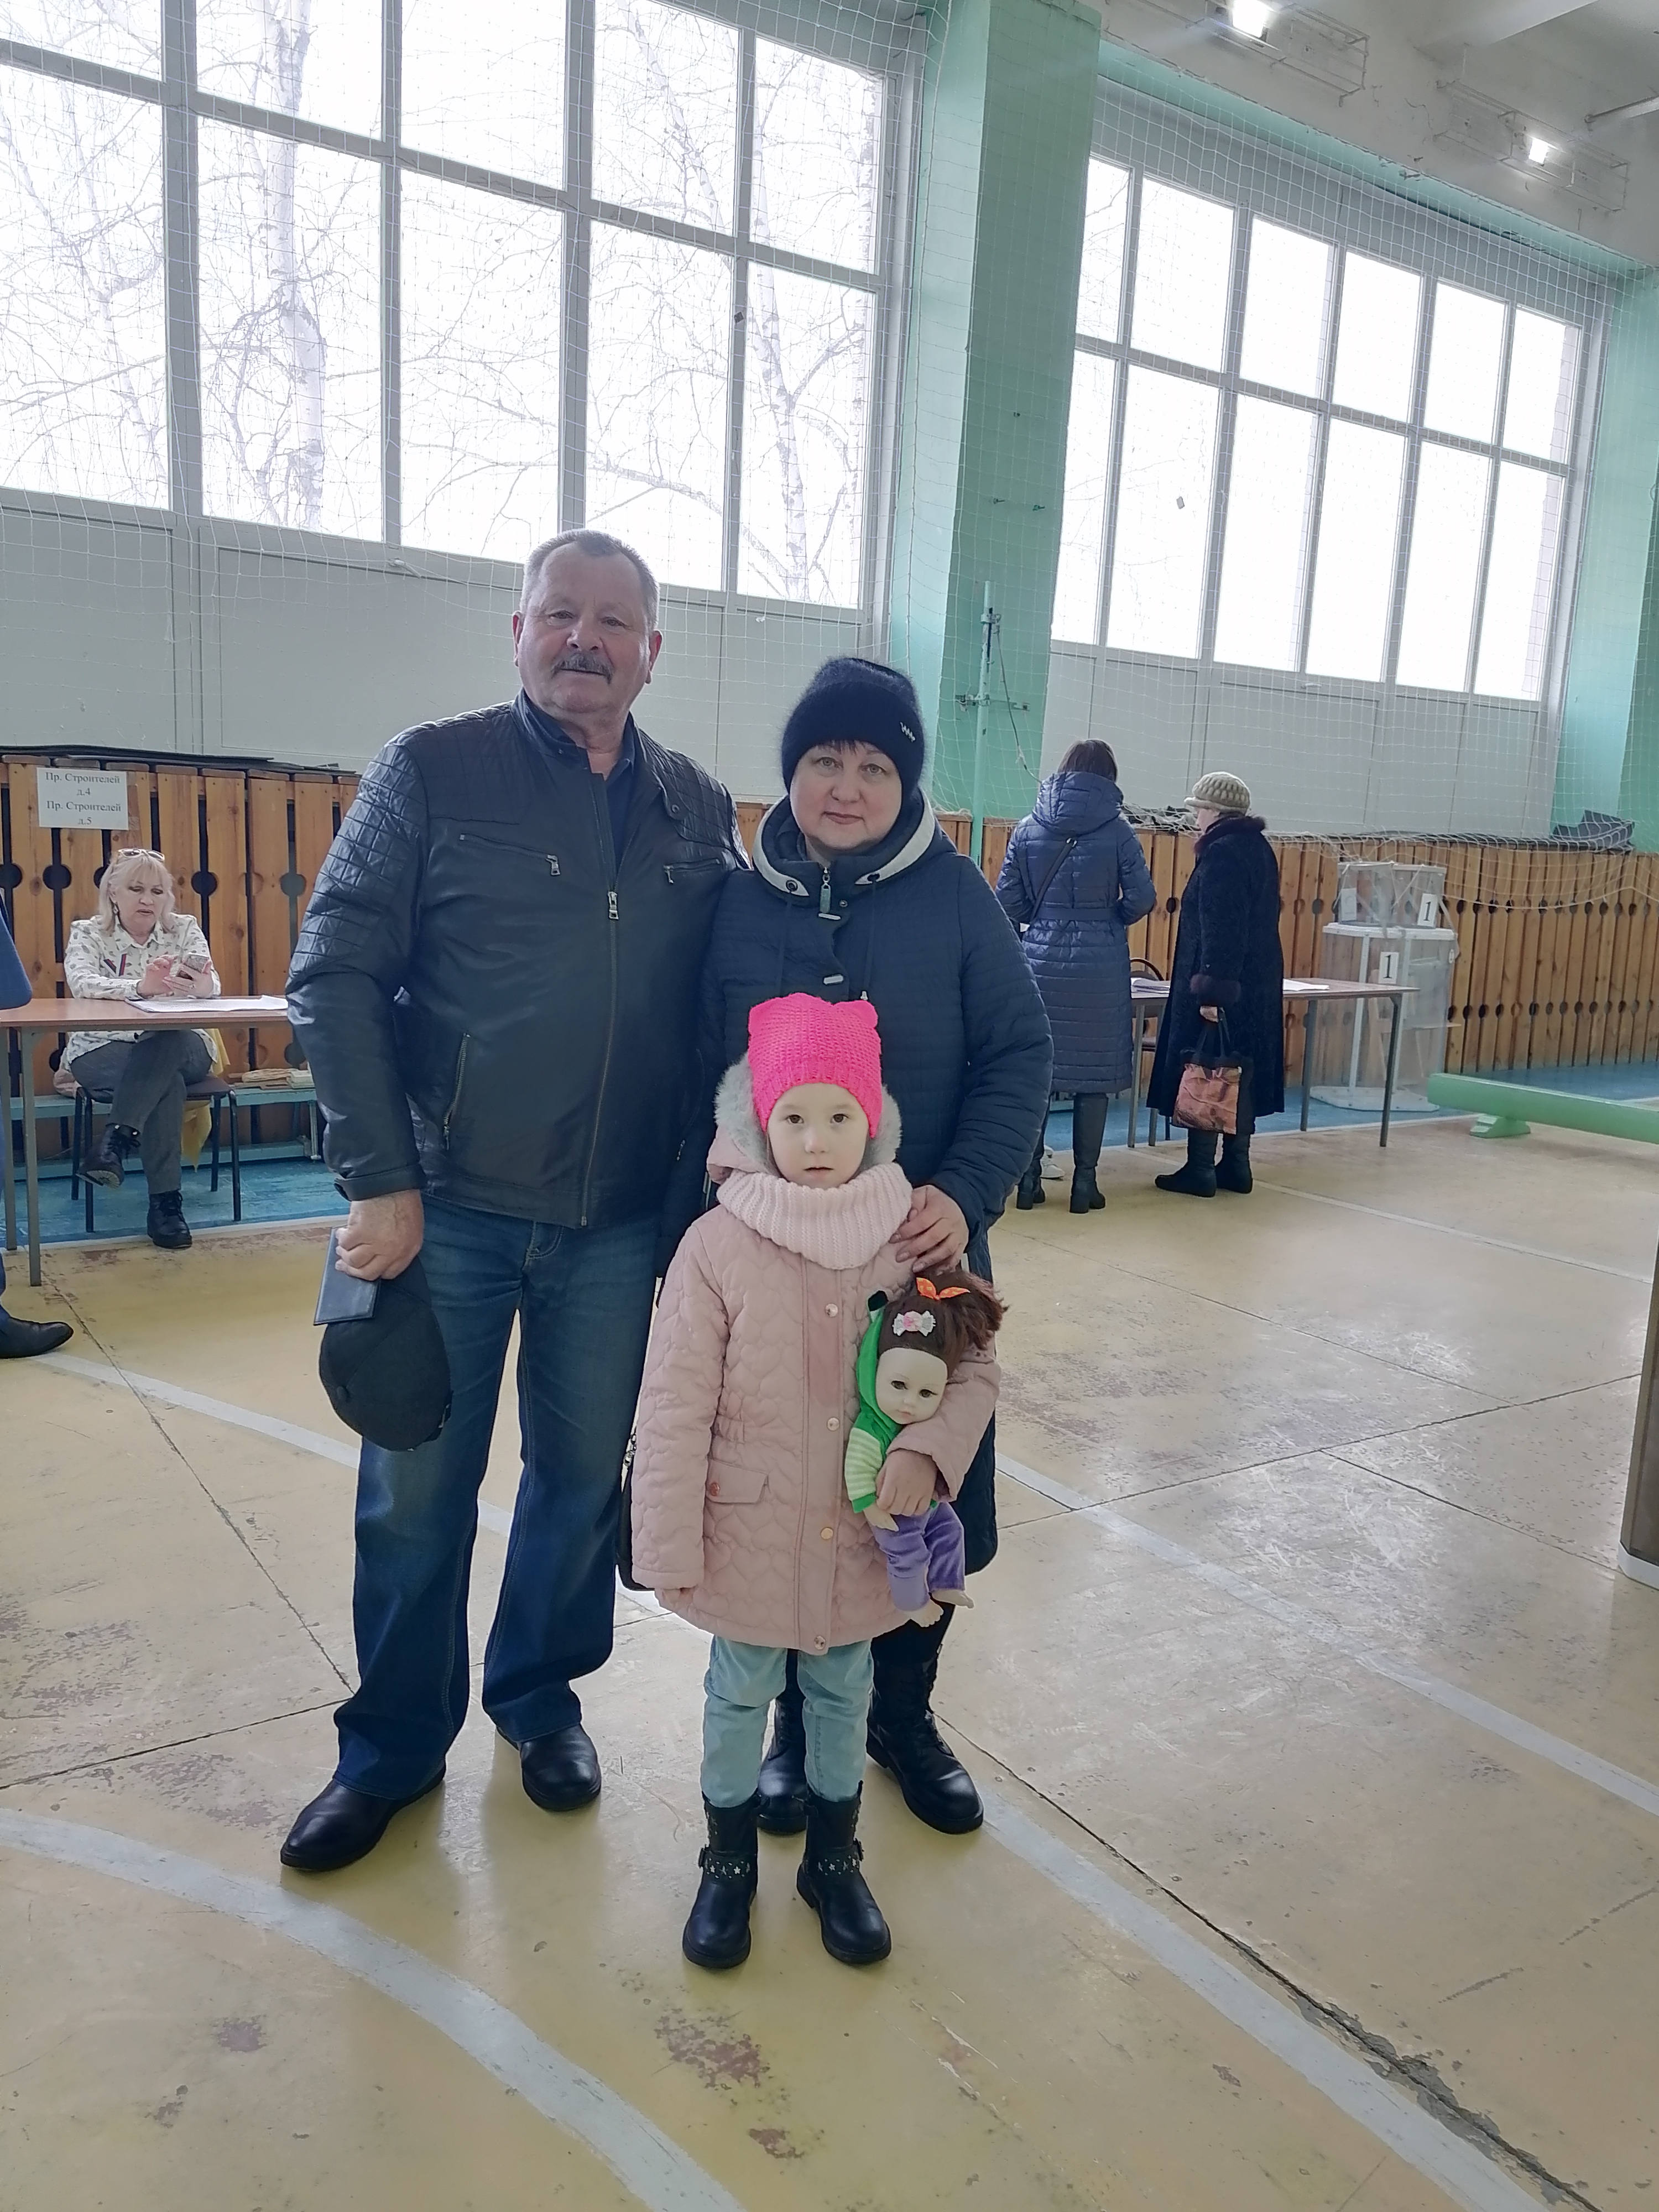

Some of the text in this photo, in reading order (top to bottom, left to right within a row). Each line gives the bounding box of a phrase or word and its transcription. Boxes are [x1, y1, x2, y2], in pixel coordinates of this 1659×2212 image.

[45, 772, 120, 784] Пр. Строителей
[76, 787, 91, 796] д.4
[46, 801, 121, 812] Пр. Строителей
[78, 817, 92, 825] д.5
[1423, 901, 1431, 922] 1
[1383, 954, 1392, 979] 1
